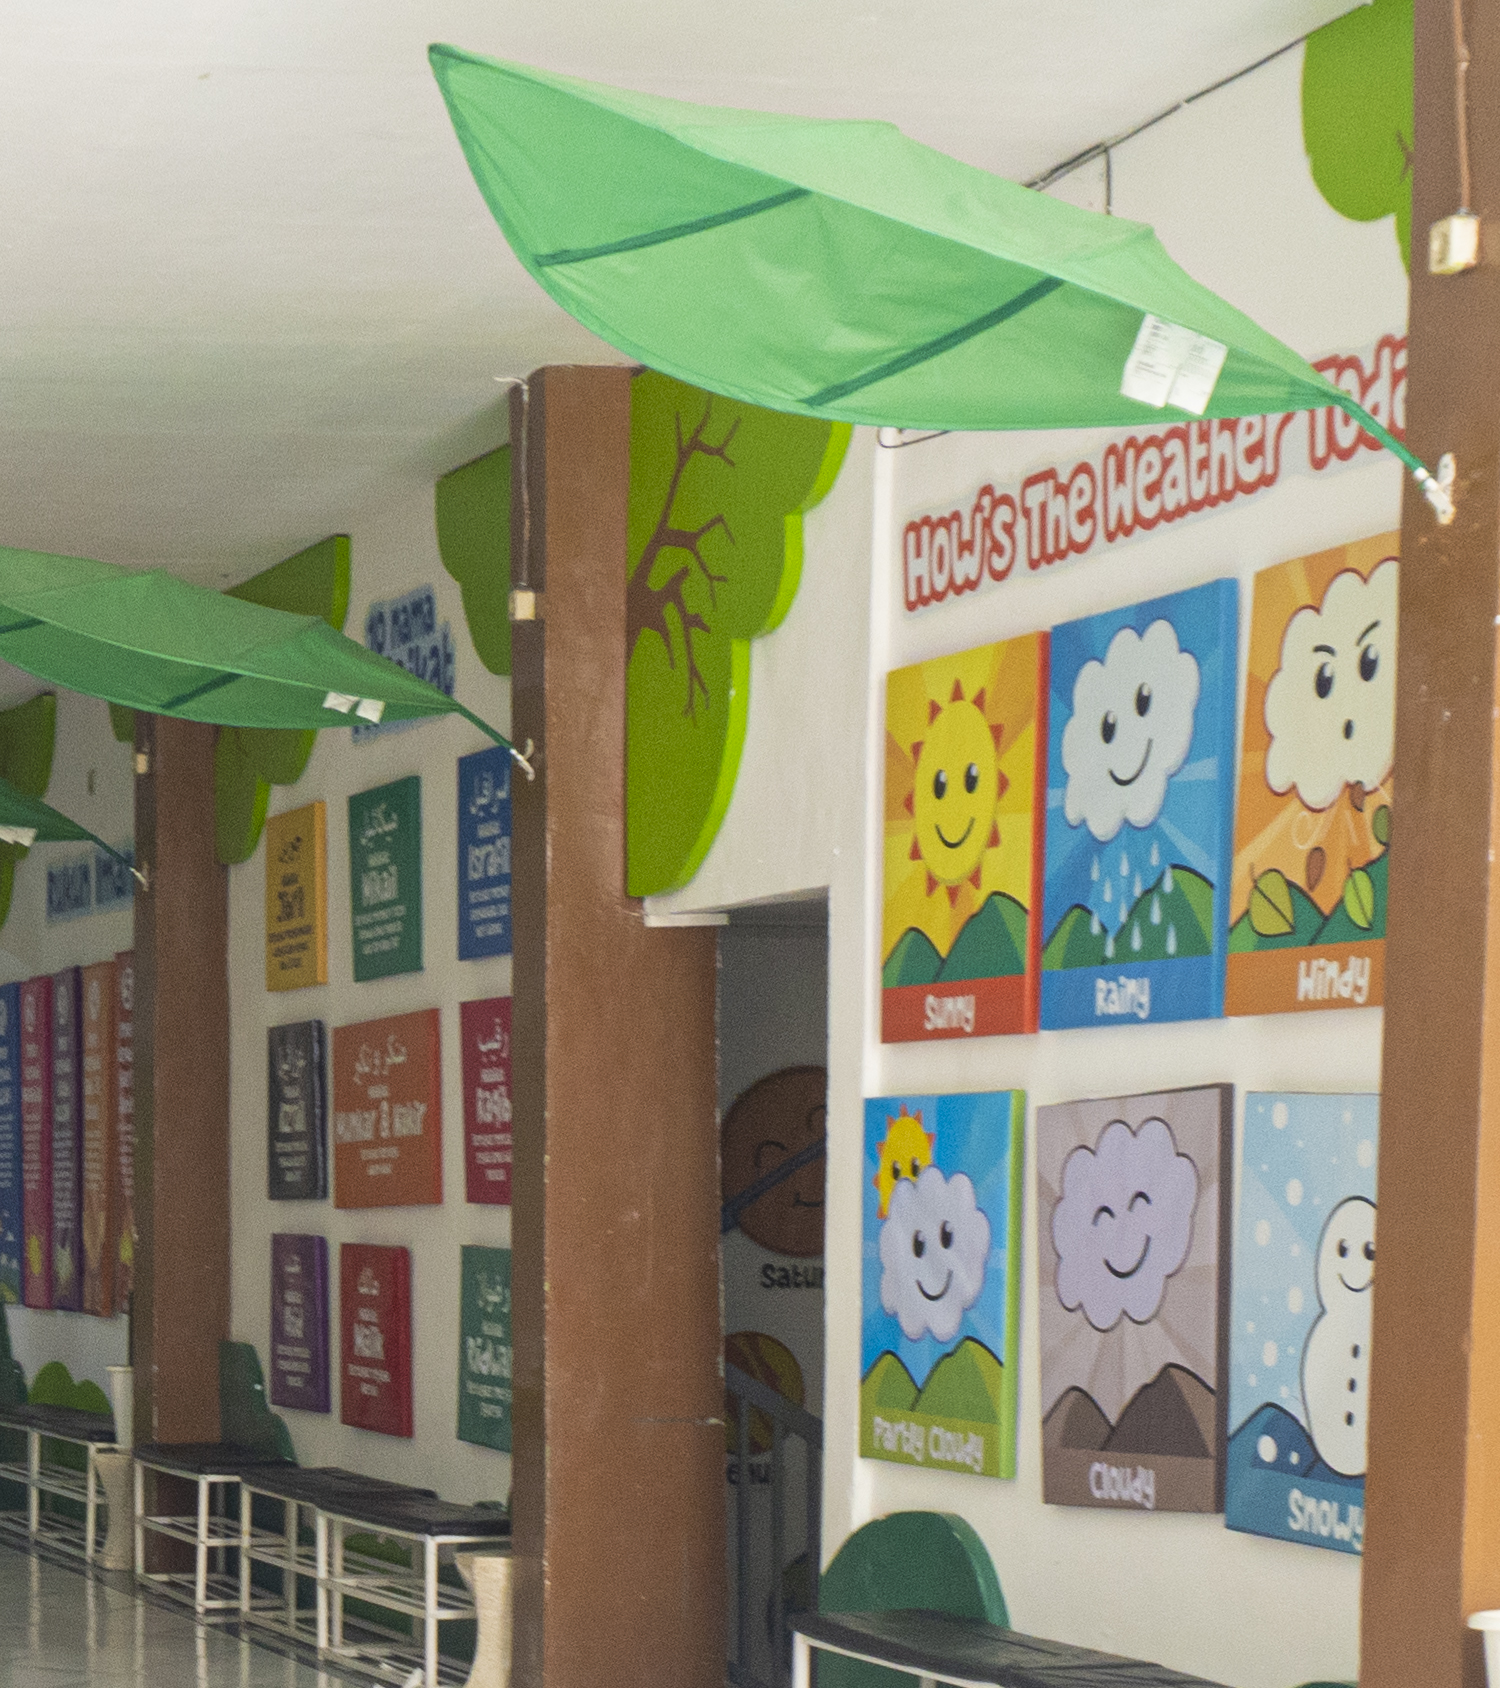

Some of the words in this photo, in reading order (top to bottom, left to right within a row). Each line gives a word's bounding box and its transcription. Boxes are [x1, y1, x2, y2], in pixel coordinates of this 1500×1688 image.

[1021, 467, 1096, 570] The
[1103, 412, 1295, 543] Weather
[1095, 975, 1151, 1019] Rainy
[1296, 956, 1371, 1004] Windy
[873, 1415, 925, 1462] Partly
[928, 1425, 984, 1473] Cloudy
[1089, 1461, 1156, 1510] Cloudy
